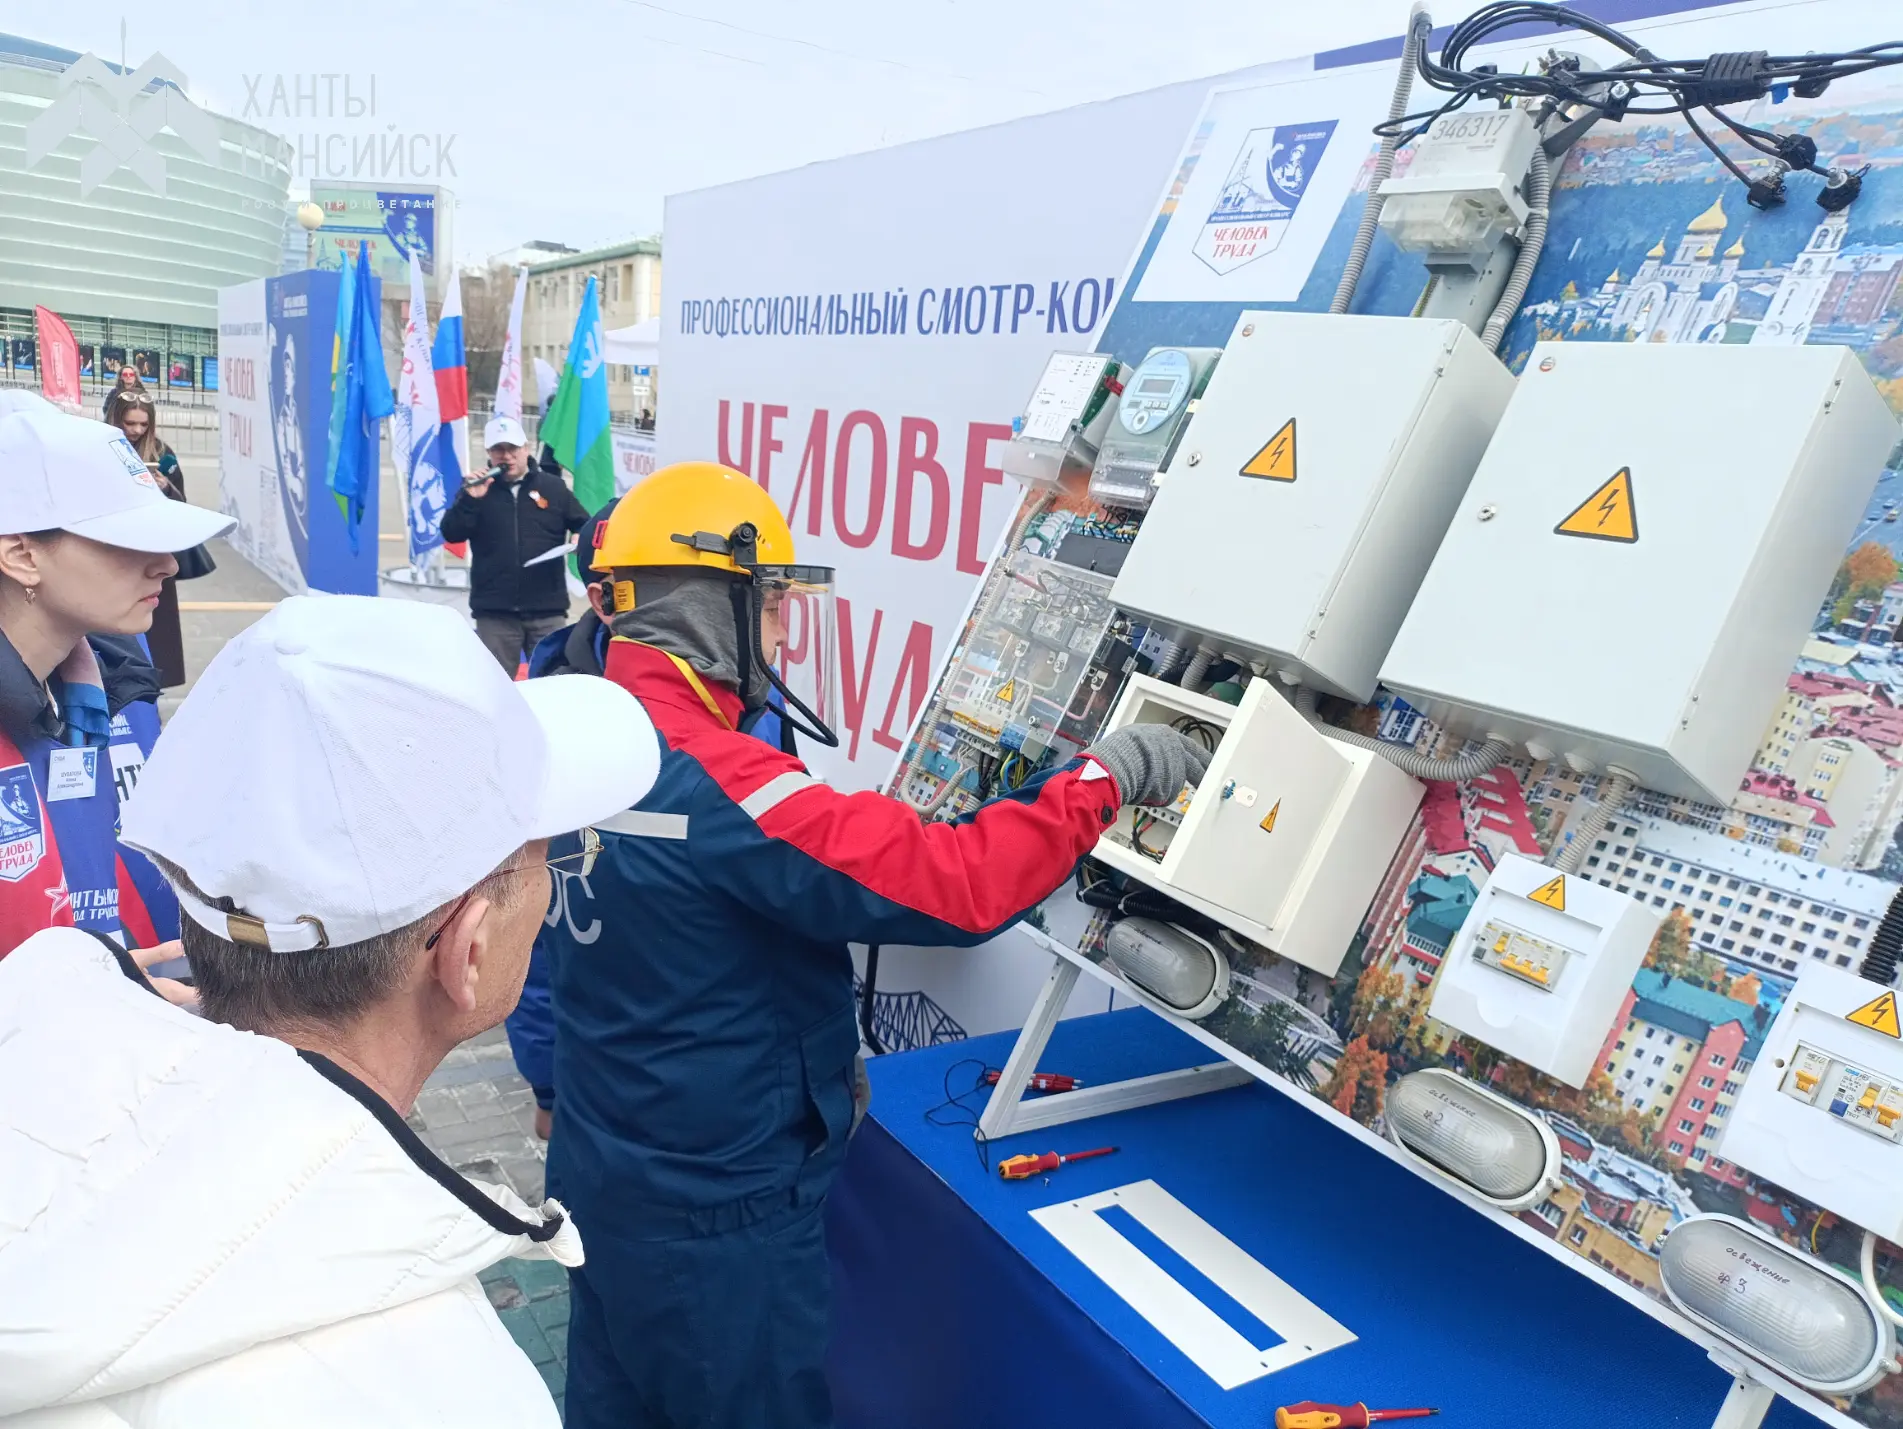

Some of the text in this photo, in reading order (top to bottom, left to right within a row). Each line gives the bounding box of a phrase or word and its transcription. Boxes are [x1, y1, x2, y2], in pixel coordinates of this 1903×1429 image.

[1432, 115, 1510, 140] 346317
[1214, 226, 1269, 241] ЧЕЛОВЕК
[1213, 243, 1257, 259] ТРУДА
[681, 287, 907, 336] ПРОФЕССИОНАЛЬНЫЙ
[224, 357, 256, 401] ЧЕЛОВЕК
[717, 399, 1024, 577] ЧЕЛОВЕ
[1725, 1247, 1790, 1284] освещение
[1733, 1277, 1748, 1294] 3
